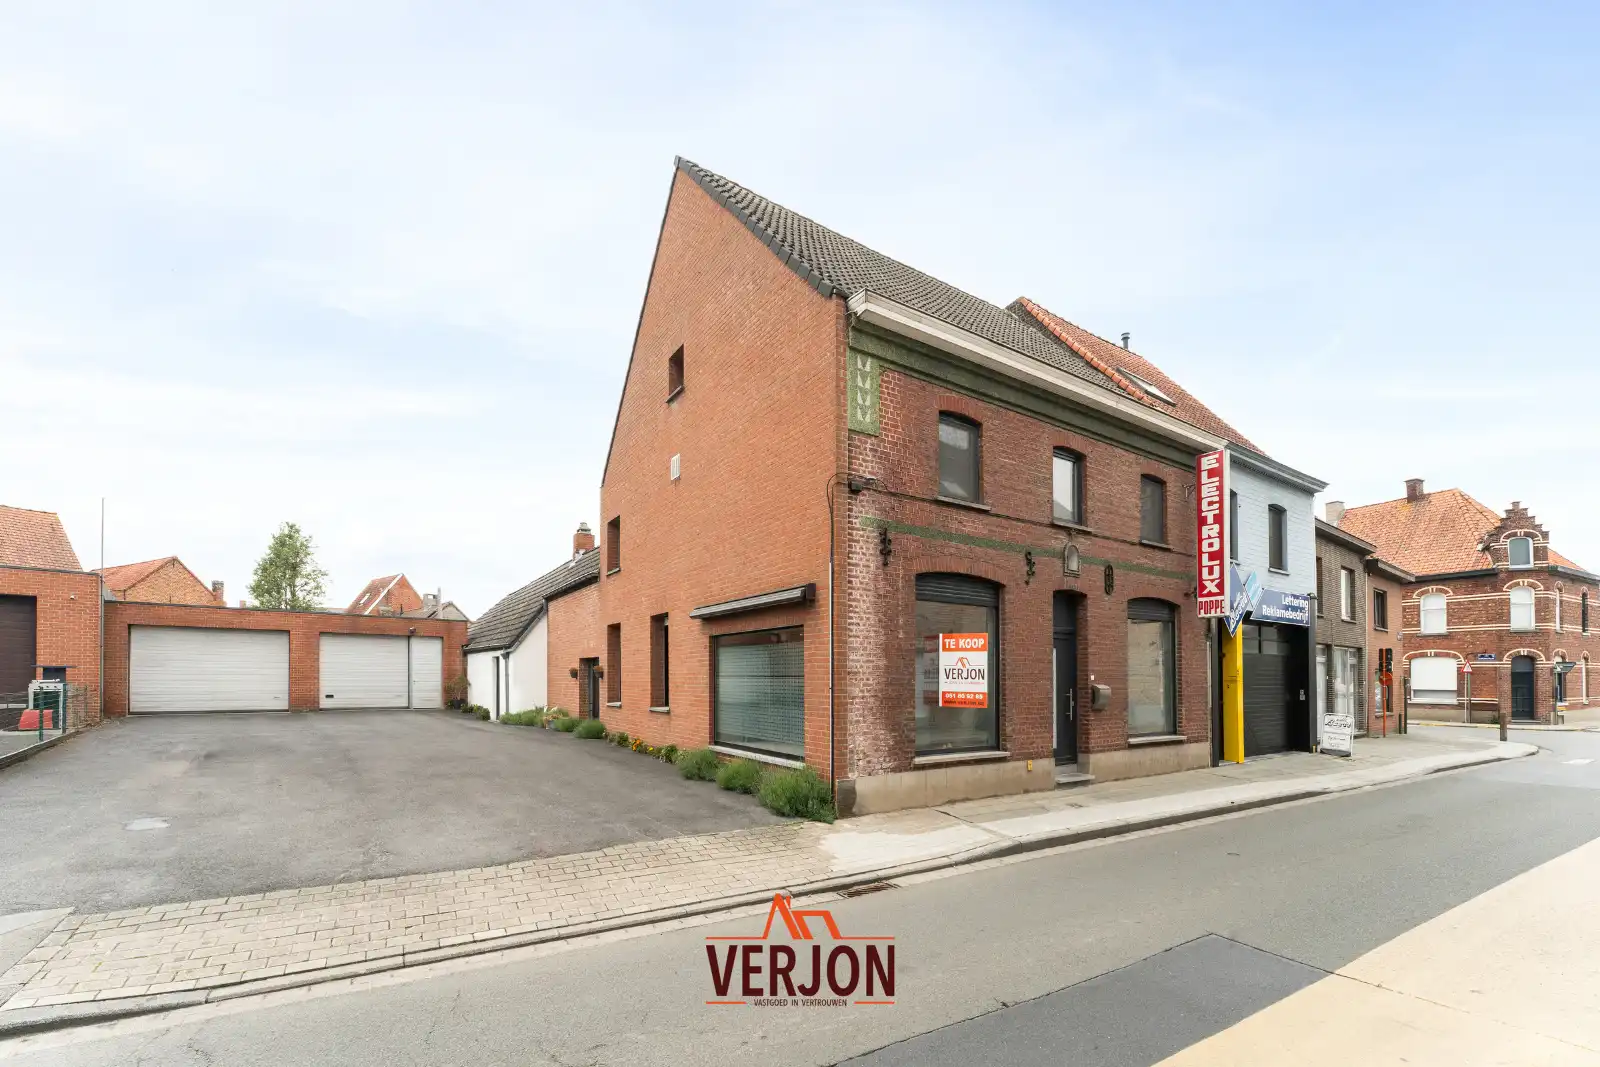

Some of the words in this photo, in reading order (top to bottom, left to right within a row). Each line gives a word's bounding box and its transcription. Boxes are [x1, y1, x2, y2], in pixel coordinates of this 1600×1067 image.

[1200, 453, 1220, 595] ELECTROLUX
[1198, 599, 1225, 615] POPPE
[1281, 594, 1309, 611] Lettering
[1262, 604, 1309, 623] Reklamebedrijf
[944, 638, 956, 649] TE
[958, 638, 985, 649] KOOP
[944, 667, 985, 680] VERJON
